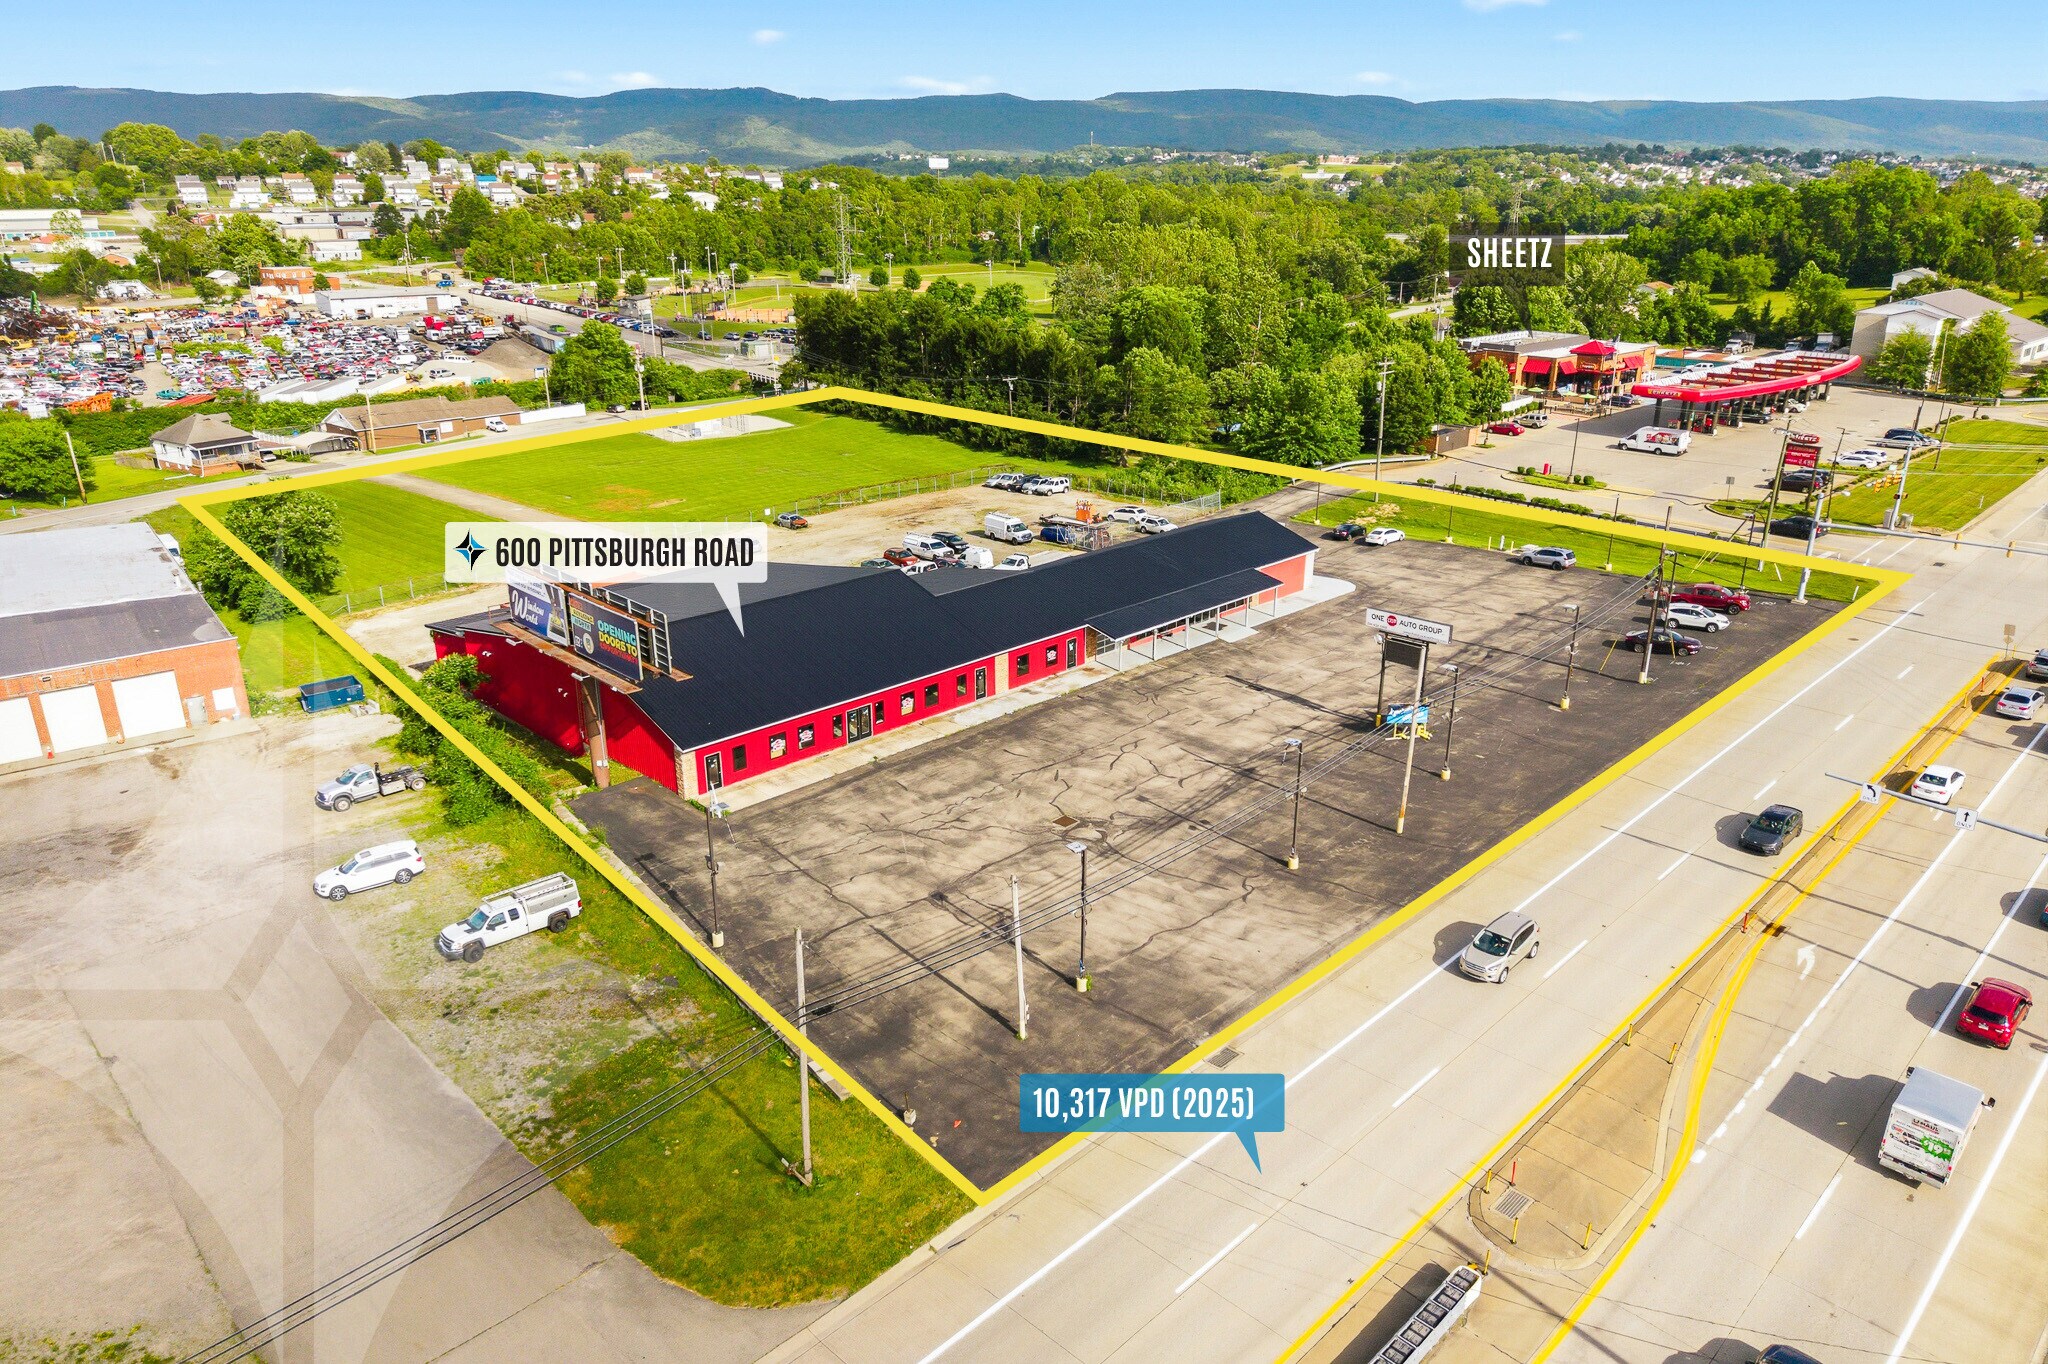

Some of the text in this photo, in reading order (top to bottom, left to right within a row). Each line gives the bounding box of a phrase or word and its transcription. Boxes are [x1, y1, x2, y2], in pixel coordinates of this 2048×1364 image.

[597, 619, 637, 646] OPENING
[1371, 613, 1385, 622] ONE
[1400, 620, 1417, 629] AUTO
[1418, 624, 1443, 635] GROUP
[598, 630, 627, 652] DOORS
[626, 643, 638, 657] TO
